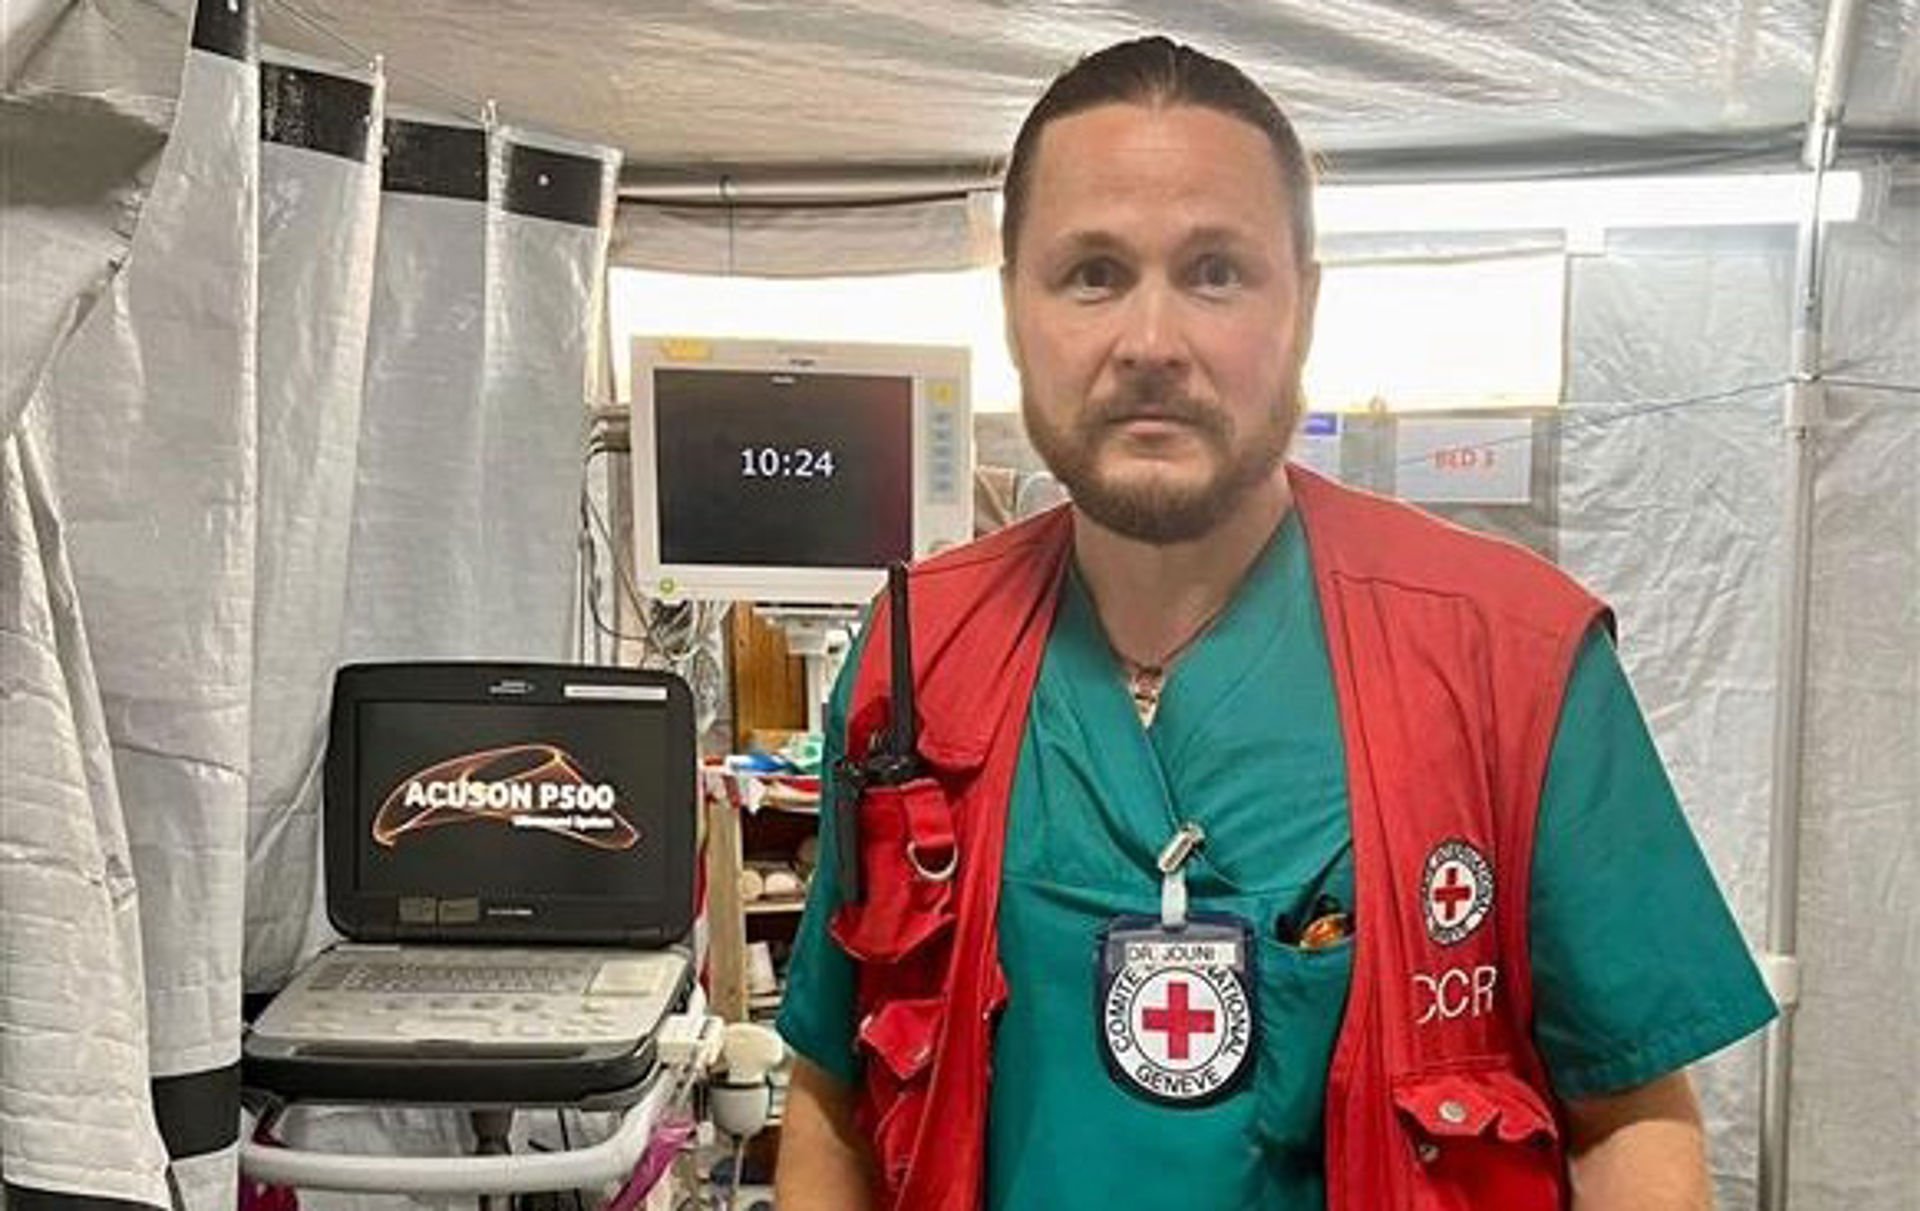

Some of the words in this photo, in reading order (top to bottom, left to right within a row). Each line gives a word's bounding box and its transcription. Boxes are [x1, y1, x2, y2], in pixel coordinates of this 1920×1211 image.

[741, 448, 834, 477] 10:24
[404, 781, 532, 809] ACUSON
[540, 785, 616, 811] P500
[1162, 946, 1216, 960] JOUNI
[1136, 1066, 1221, 1094] GENEVE
